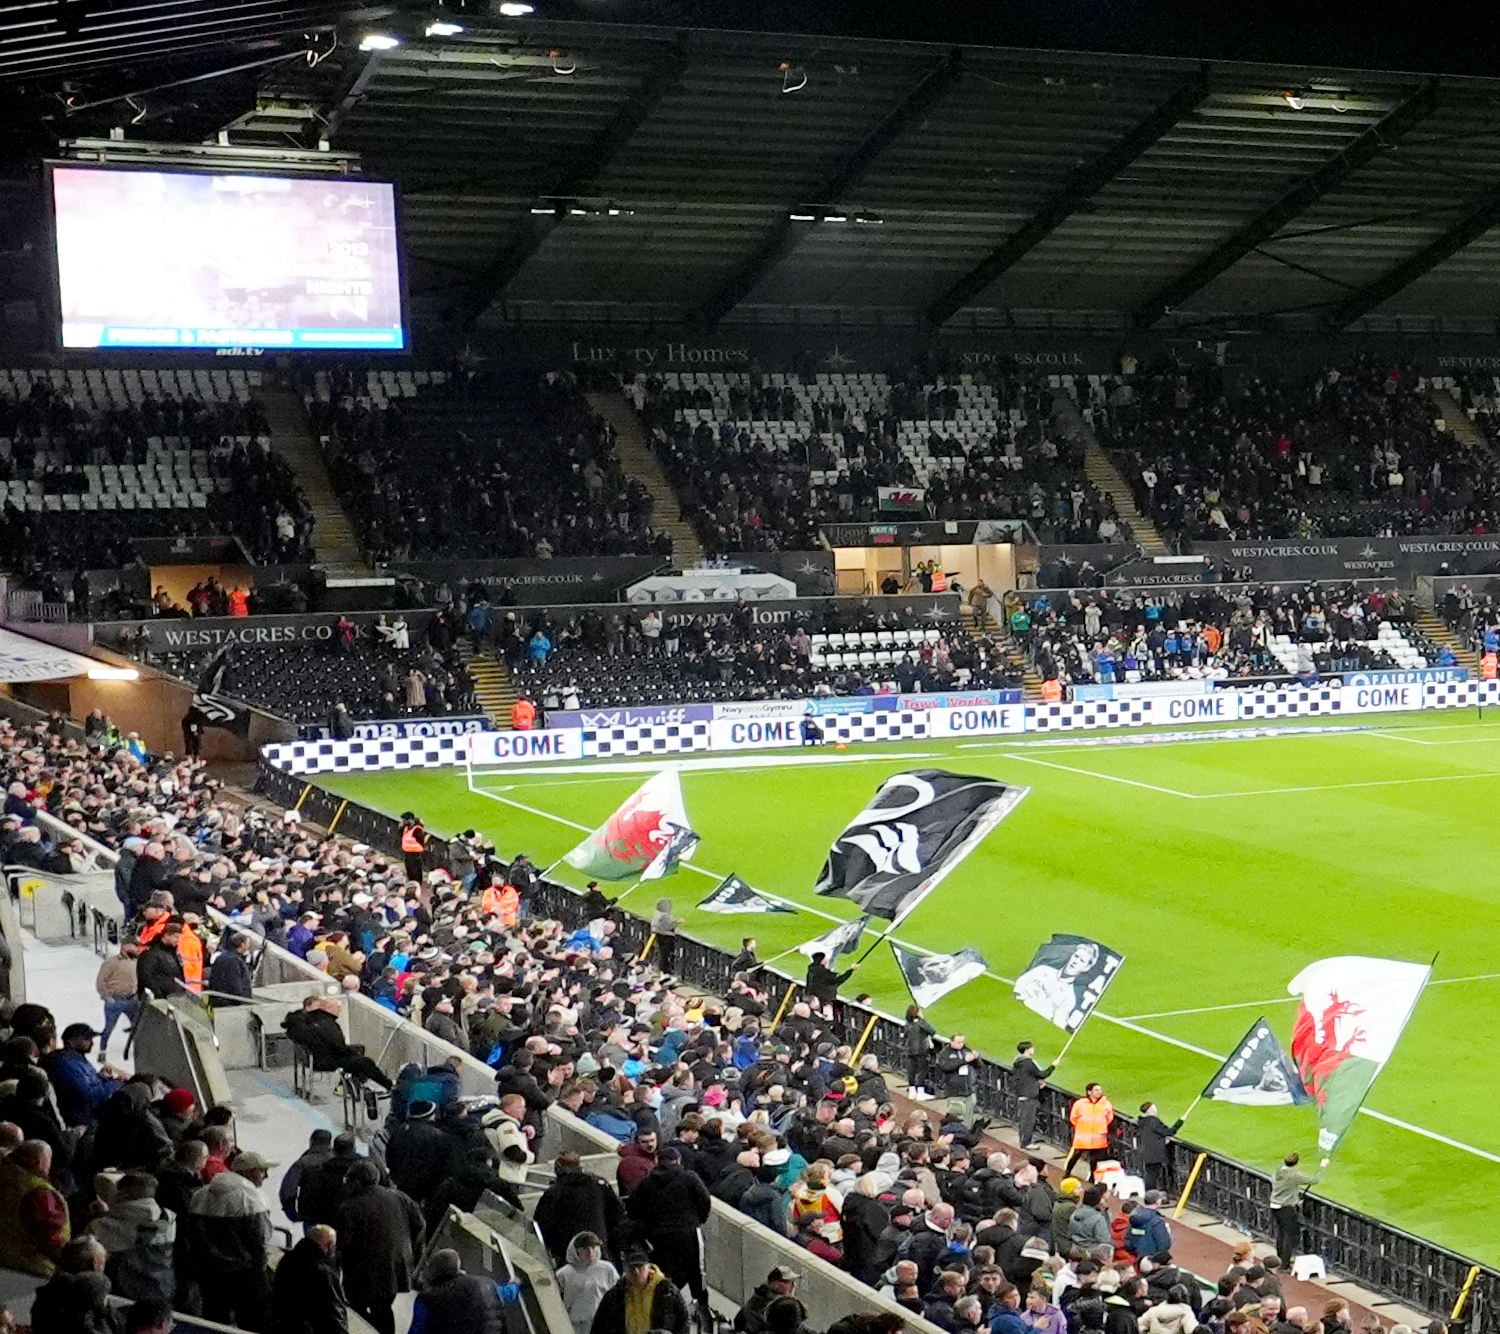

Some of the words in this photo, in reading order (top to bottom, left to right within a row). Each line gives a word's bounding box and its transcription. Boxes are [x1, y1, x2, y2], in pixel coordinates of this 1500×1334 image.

[305, 280, 373, 296] NIGHTS
[215, 347, 265, 357] adi.tv
[573, 342, 659, 366] Luxry
[667, 343, 749, 362] Homes
[1230, 545, 1339, 558] WESTACRES.CO.UK
[1399, 540, 1500, 554] WESTACRES.CO.UK
[1343, 561, 1395, 571] WESTACRES
[166, 623, 370, 647] WESTACRES.COK
[1371, 669, 1455, 686] FAIRPLANE
[1357, 687, 1411, 708] COME
[625, 708, 686, 726] kwiff
[1169, 696, 1227, 719] COME
[949, 709, 1011, 733] COME
[729, 720, 798, 744] COME
[493, 733, 567, 758] COME
